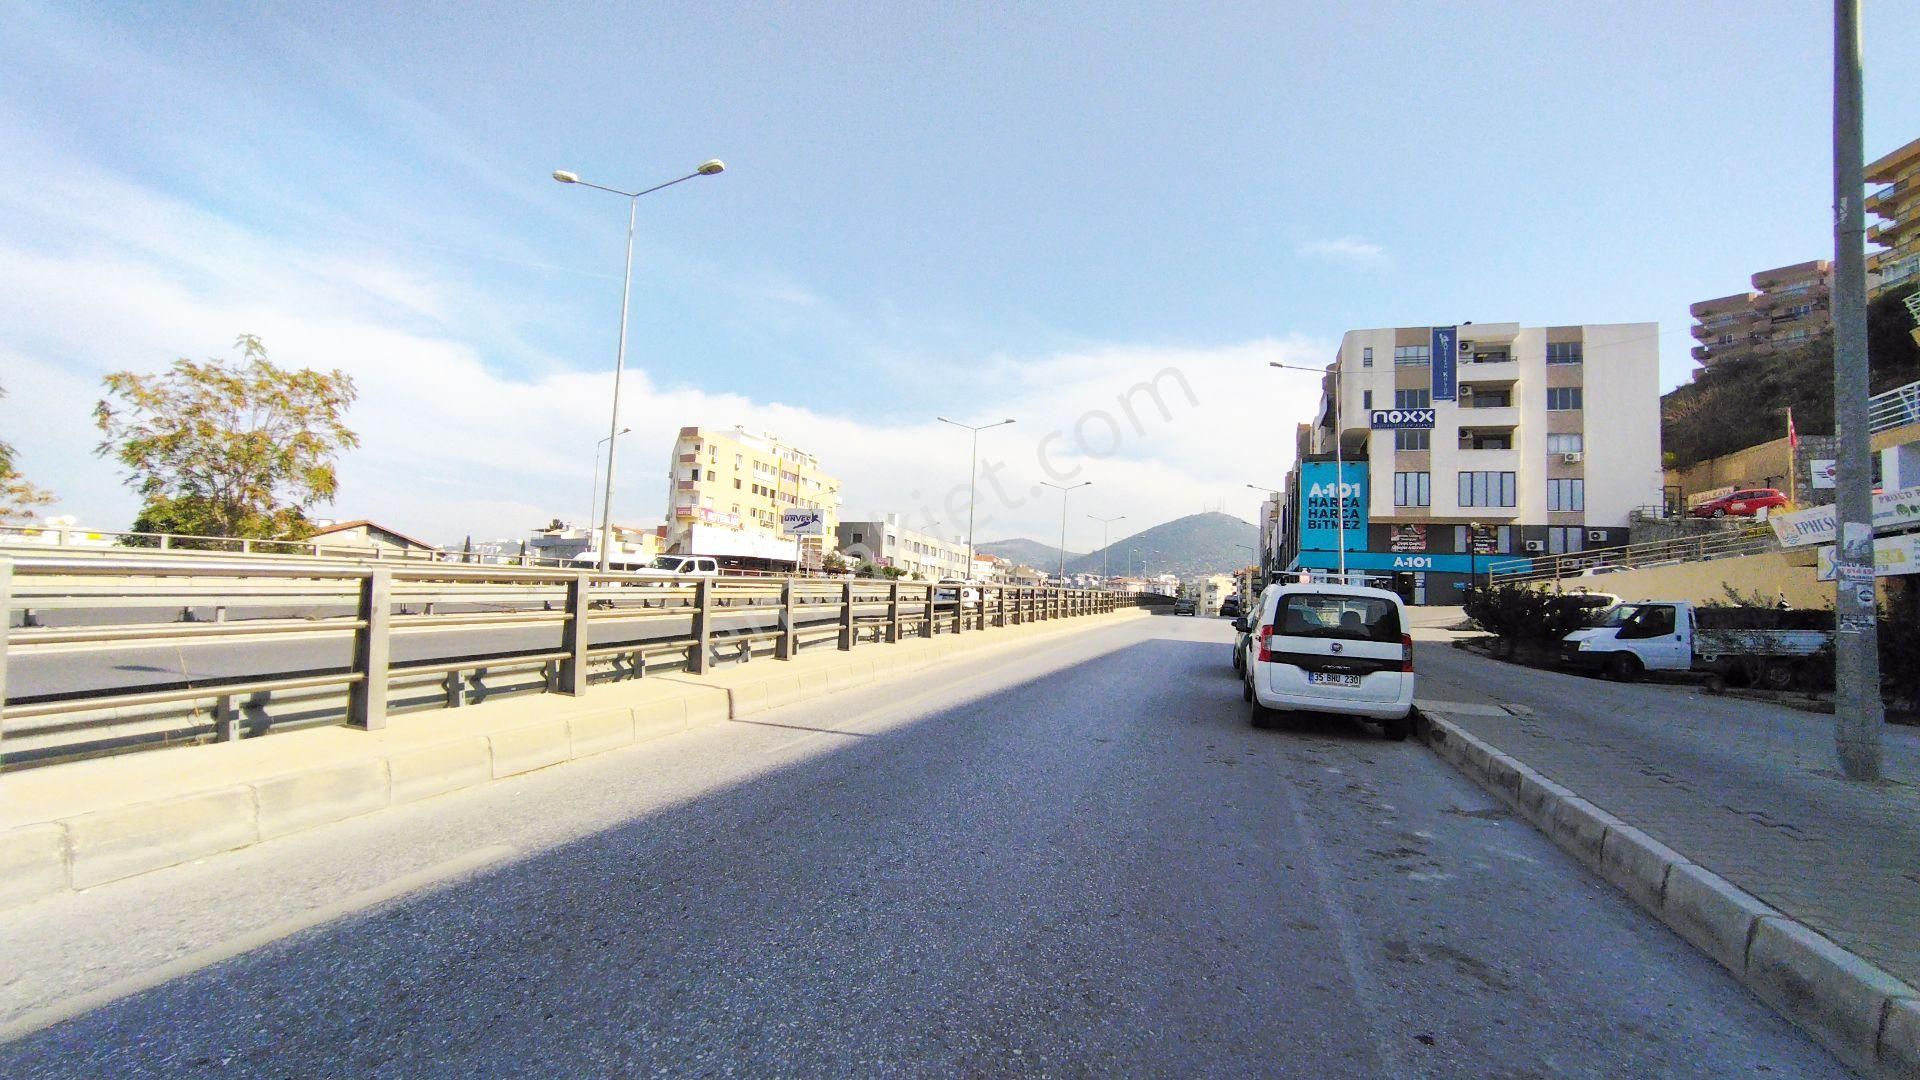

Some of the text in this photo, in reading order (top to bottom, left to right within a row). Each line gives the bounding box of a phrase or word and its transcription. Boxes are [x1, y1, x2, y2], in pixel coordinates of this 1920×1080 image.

[1308, 497, 1360, 508] HARCA
[1308, 508, 1360, 519] HARCA
[1314, 672, 1324, 682] 35
[1344, 675, 1359, 684] 230
